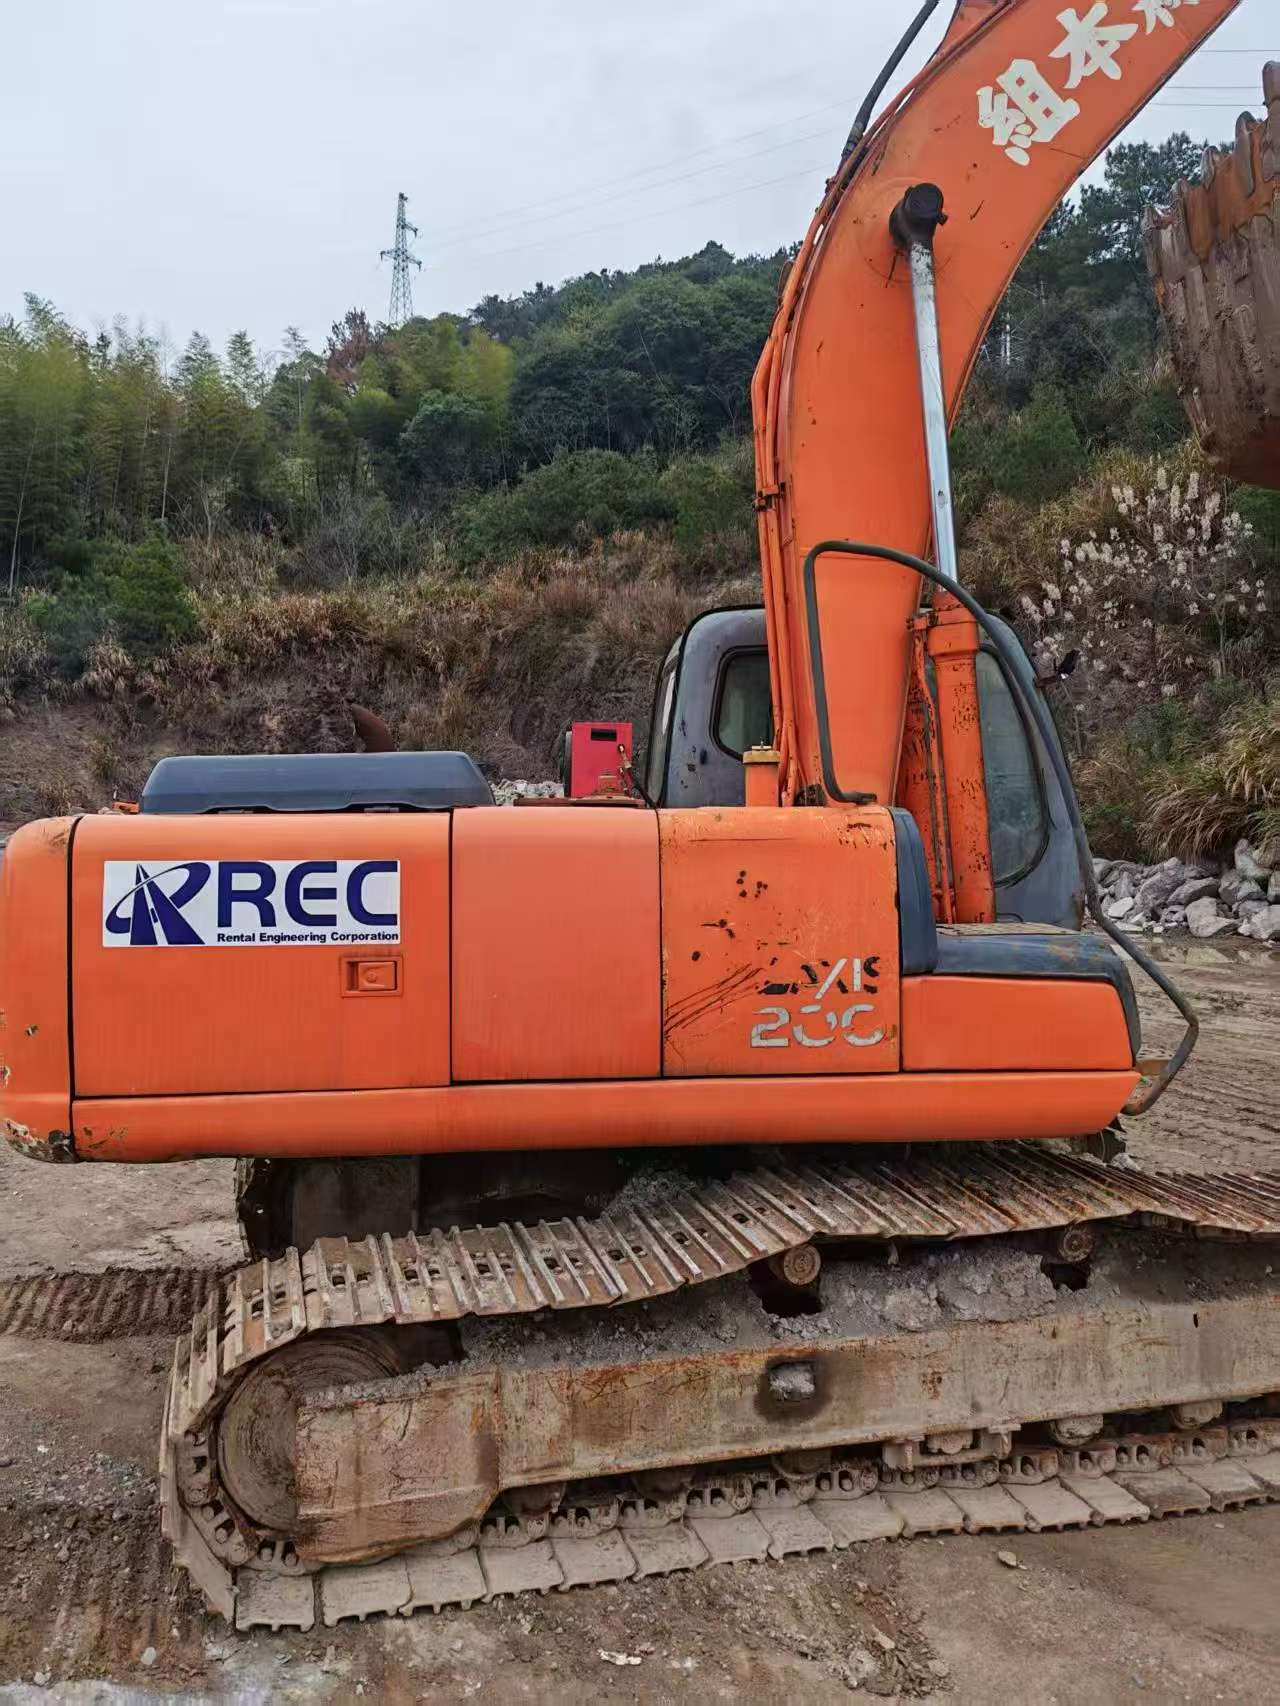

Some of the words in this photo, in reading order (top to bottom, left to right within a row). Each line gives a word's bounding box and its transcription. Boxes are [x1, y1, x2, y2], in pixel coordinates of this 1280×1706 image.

[218, 860, 398, 927] REC
[217, 932, 256, 942] Rental
[259, 932, 327, 944] Engineering
[331, 931, 399, 943] Corporation
